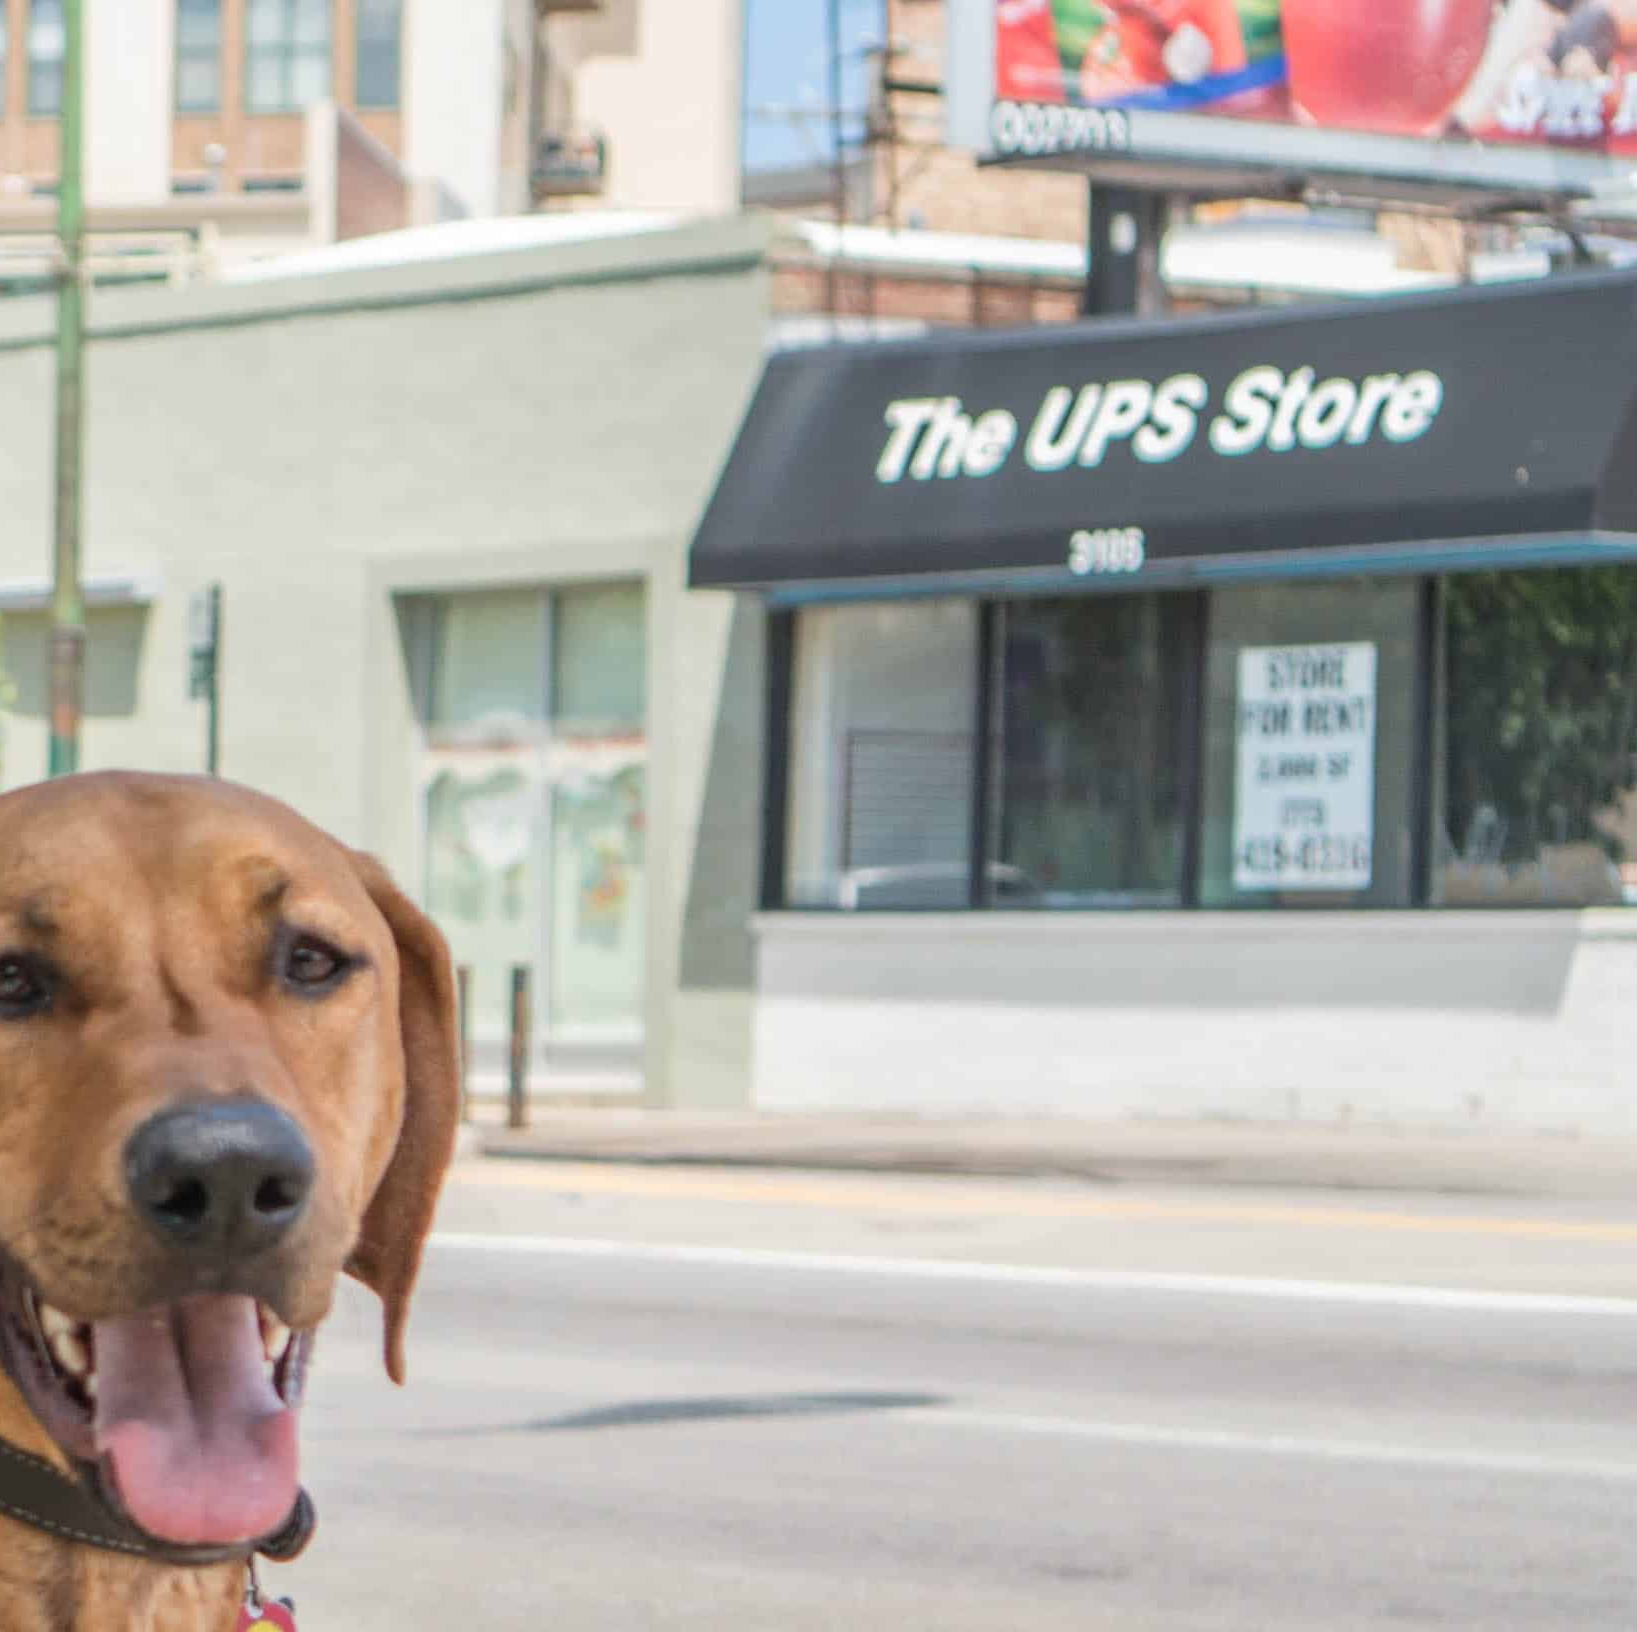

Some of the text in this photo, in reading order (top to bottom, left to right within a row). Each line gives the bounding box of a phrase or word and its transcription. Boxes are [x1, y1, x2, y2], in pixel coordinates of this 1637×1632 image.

[875, 364, 1443, 483] The UPS Store
[1268, 648, 1347, 690] STORE
[1237, 693, 1367, 737] FOR RENT
